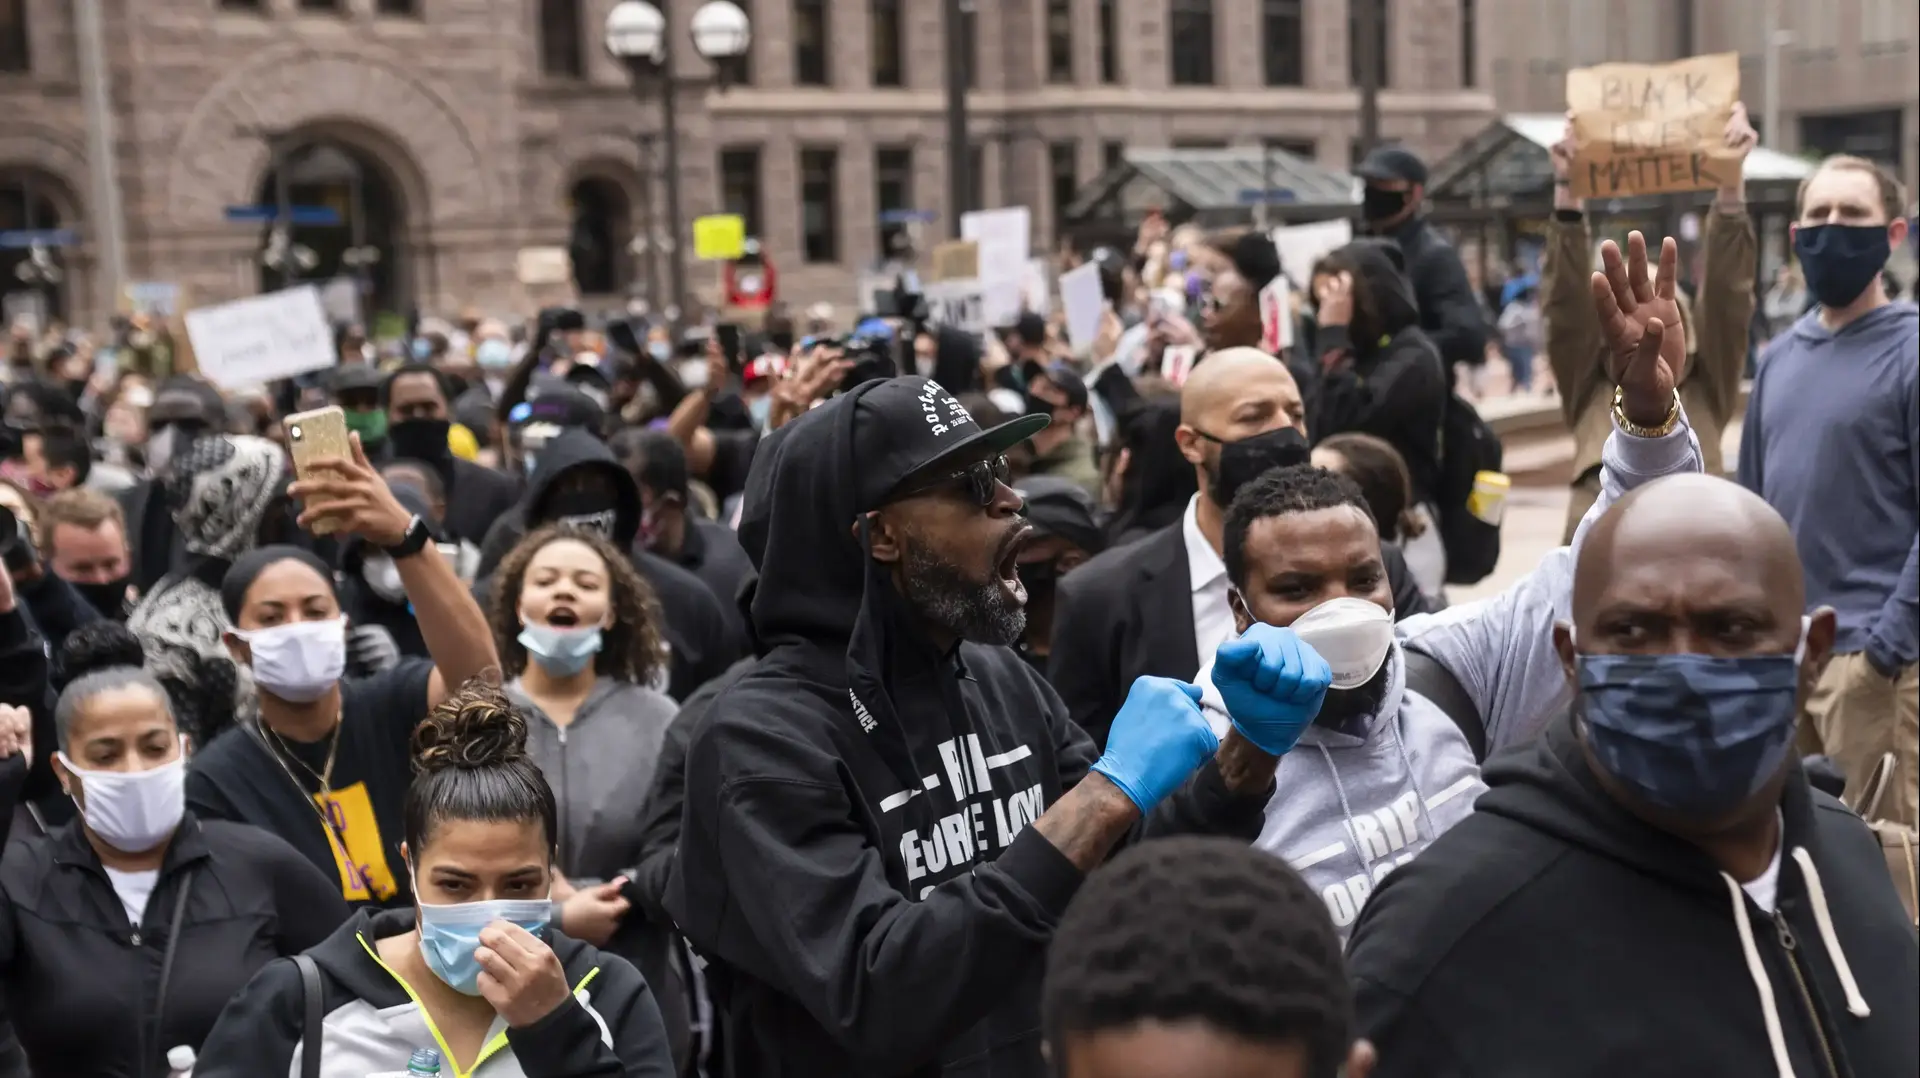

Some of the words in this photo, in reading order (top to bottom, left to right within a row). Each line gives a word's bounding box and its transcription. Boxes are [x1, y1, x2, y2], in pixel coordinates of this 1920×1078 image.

[1602, 73, 1712, 113] BLACK
[1610, 114, 1705, 153] LIVES
[1589, 151, 1724, 197] MATTER
[1342, 790, 1420, 865] RIP
